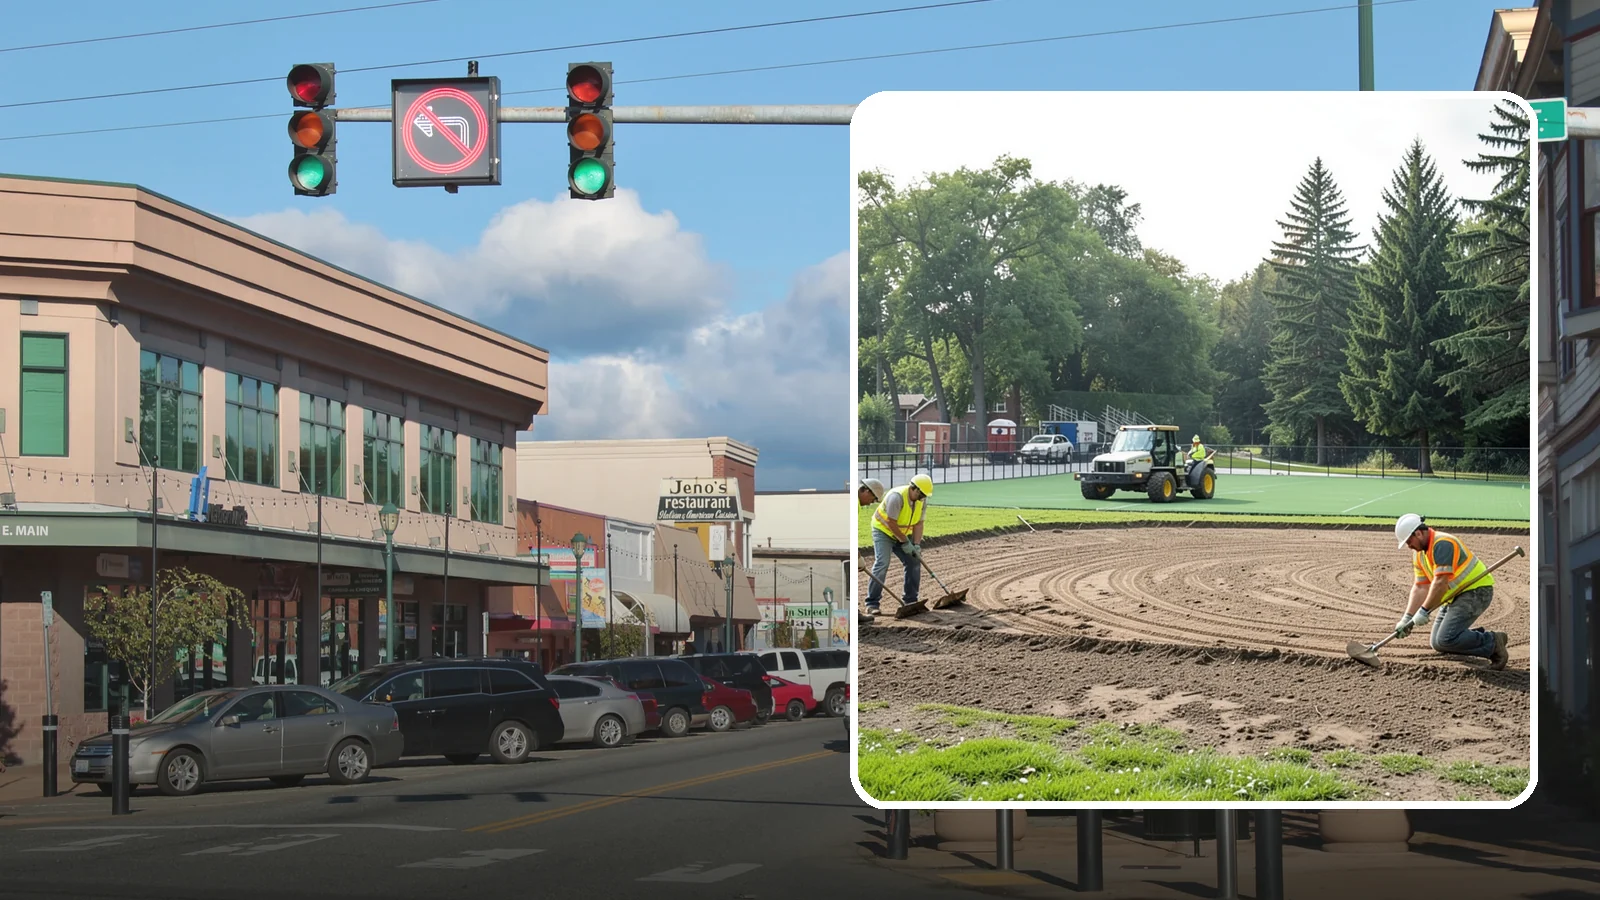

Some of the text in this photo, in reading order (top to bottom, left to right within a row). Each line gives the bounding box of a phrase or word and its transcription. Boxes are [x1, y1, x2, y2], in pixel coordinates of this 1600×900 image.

[669, 479, 727, 495] Jeno's
[664, 496, 731, 509] restaurant
[686, 509, 714, 520] American
[714, 509, 738, 520] Cuisine
[2, 525, 49, 536] E. MAIN
[797, 607, 829, 617] Street
